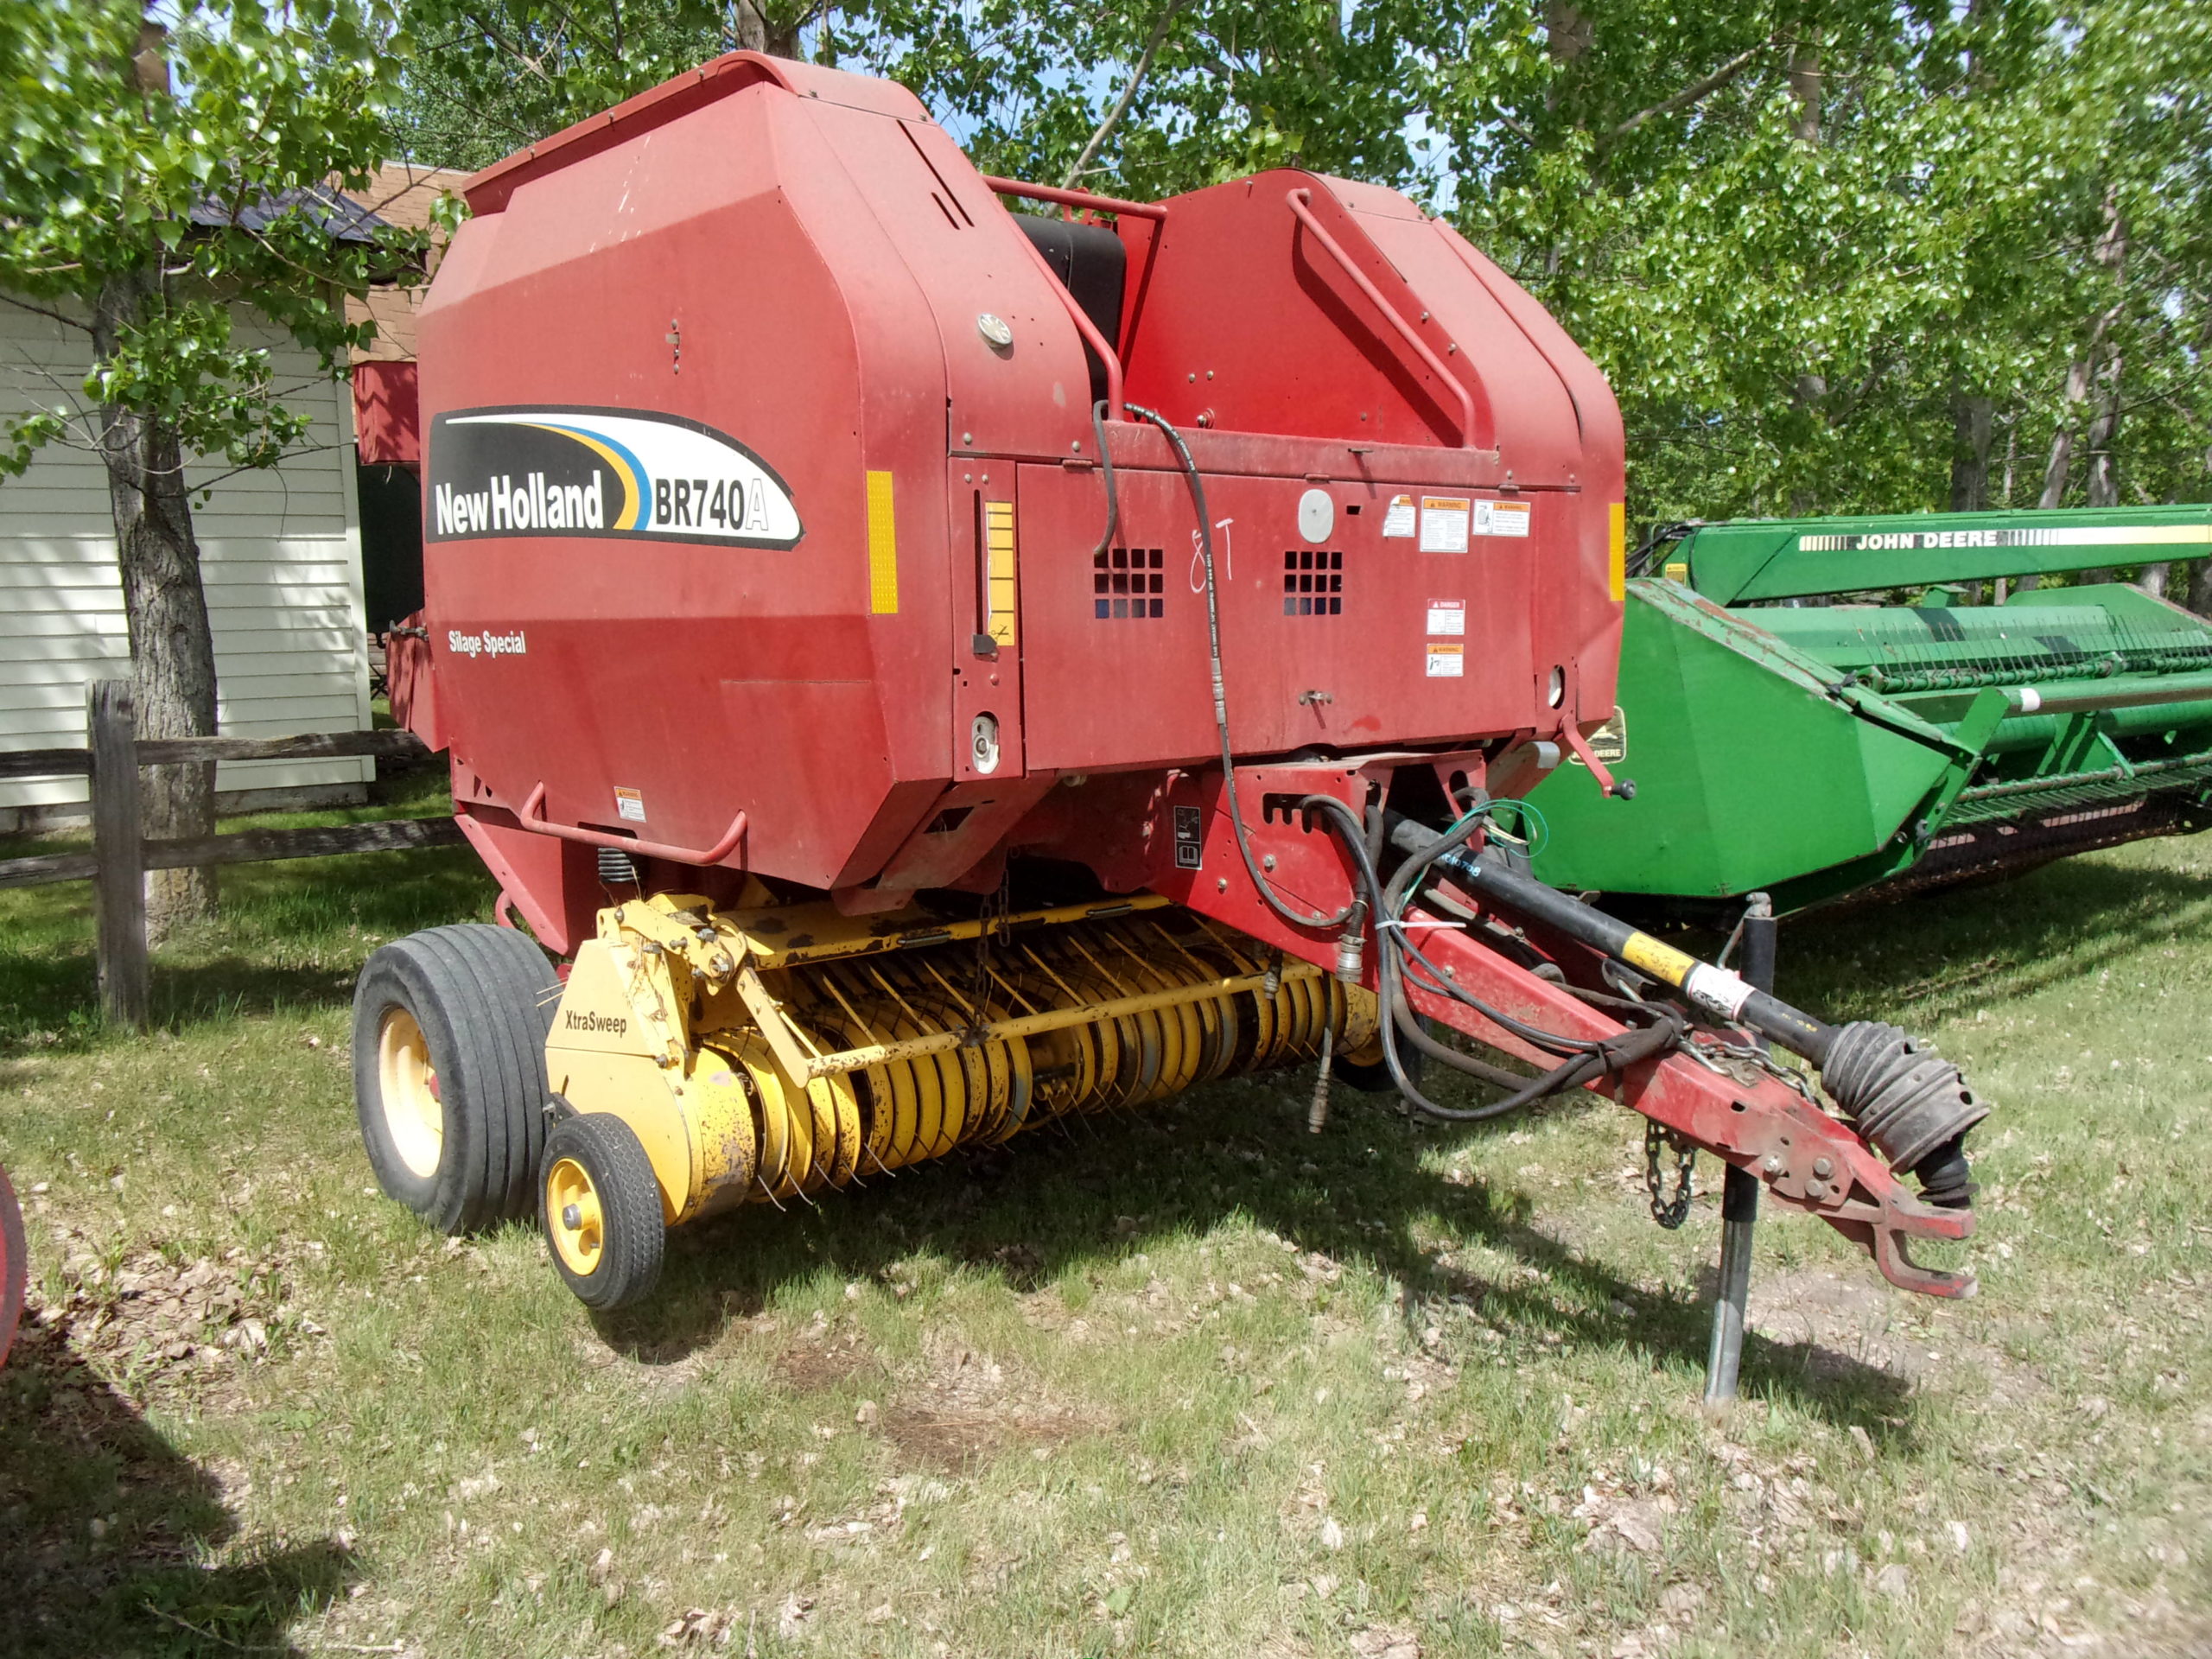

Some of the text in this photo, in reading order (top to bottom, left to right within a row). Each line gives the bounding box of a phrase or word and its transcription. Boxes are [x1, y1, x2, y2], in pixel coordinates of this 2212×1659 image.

[435, 469, 605, 536] New Holland
[655, 477, 770, 531] BR740A
[1856, 530, 1998, 550] JOHN DEERE
[448, 629, 526, 658] Silage Special
[1593, 748, 1622, 758] DEERE
[565, 1009, 627, 1039] XtraSweep
